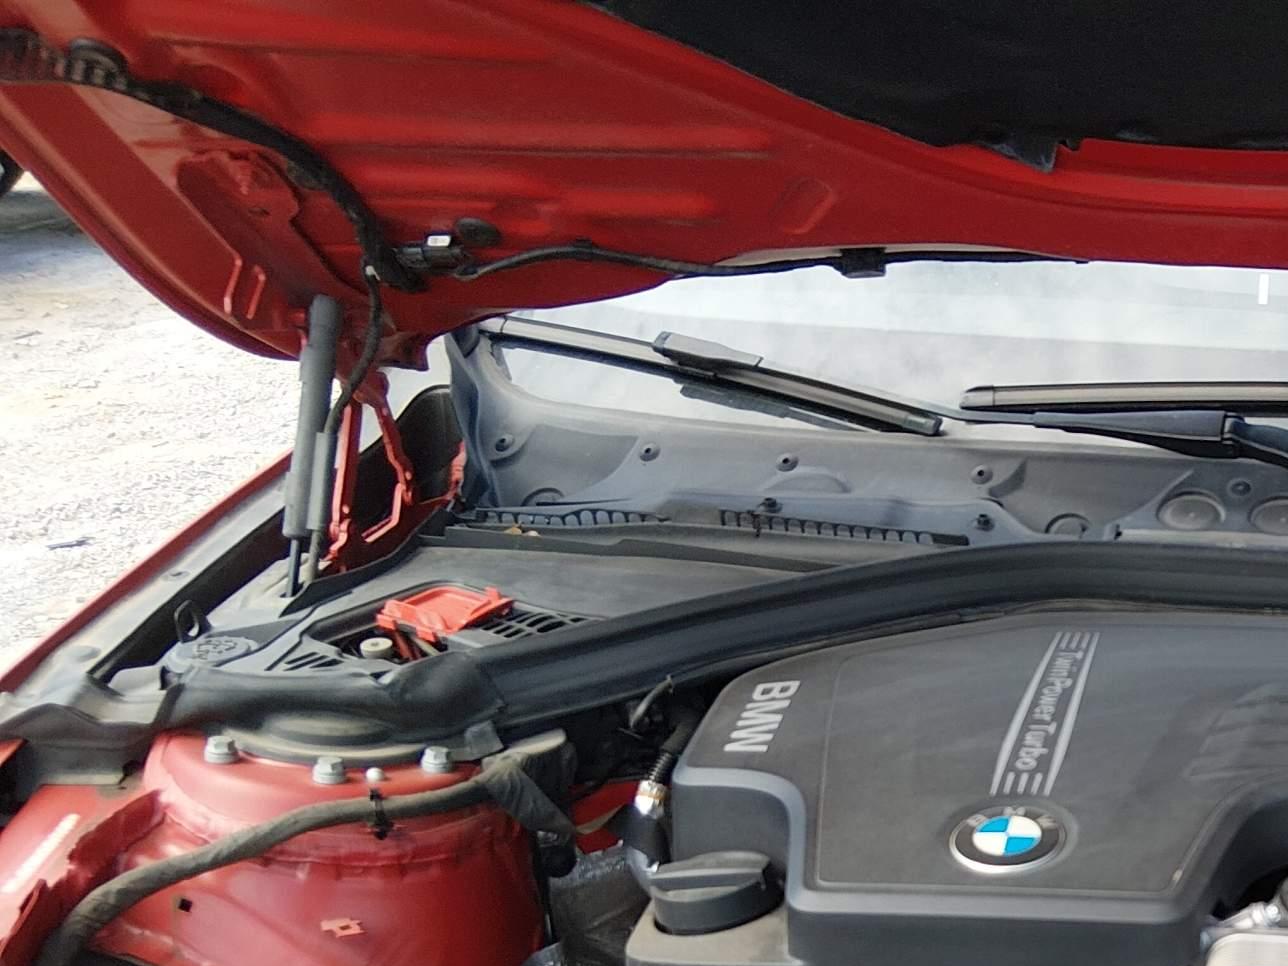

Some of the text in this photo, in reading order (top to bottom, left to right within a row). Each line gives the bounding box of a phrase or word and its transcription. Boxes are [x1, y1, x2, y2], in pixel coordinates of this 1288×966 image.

[724, 680, 800, 752] BMW
[1014, 650, 1085, 771] TwinPower Turbo
